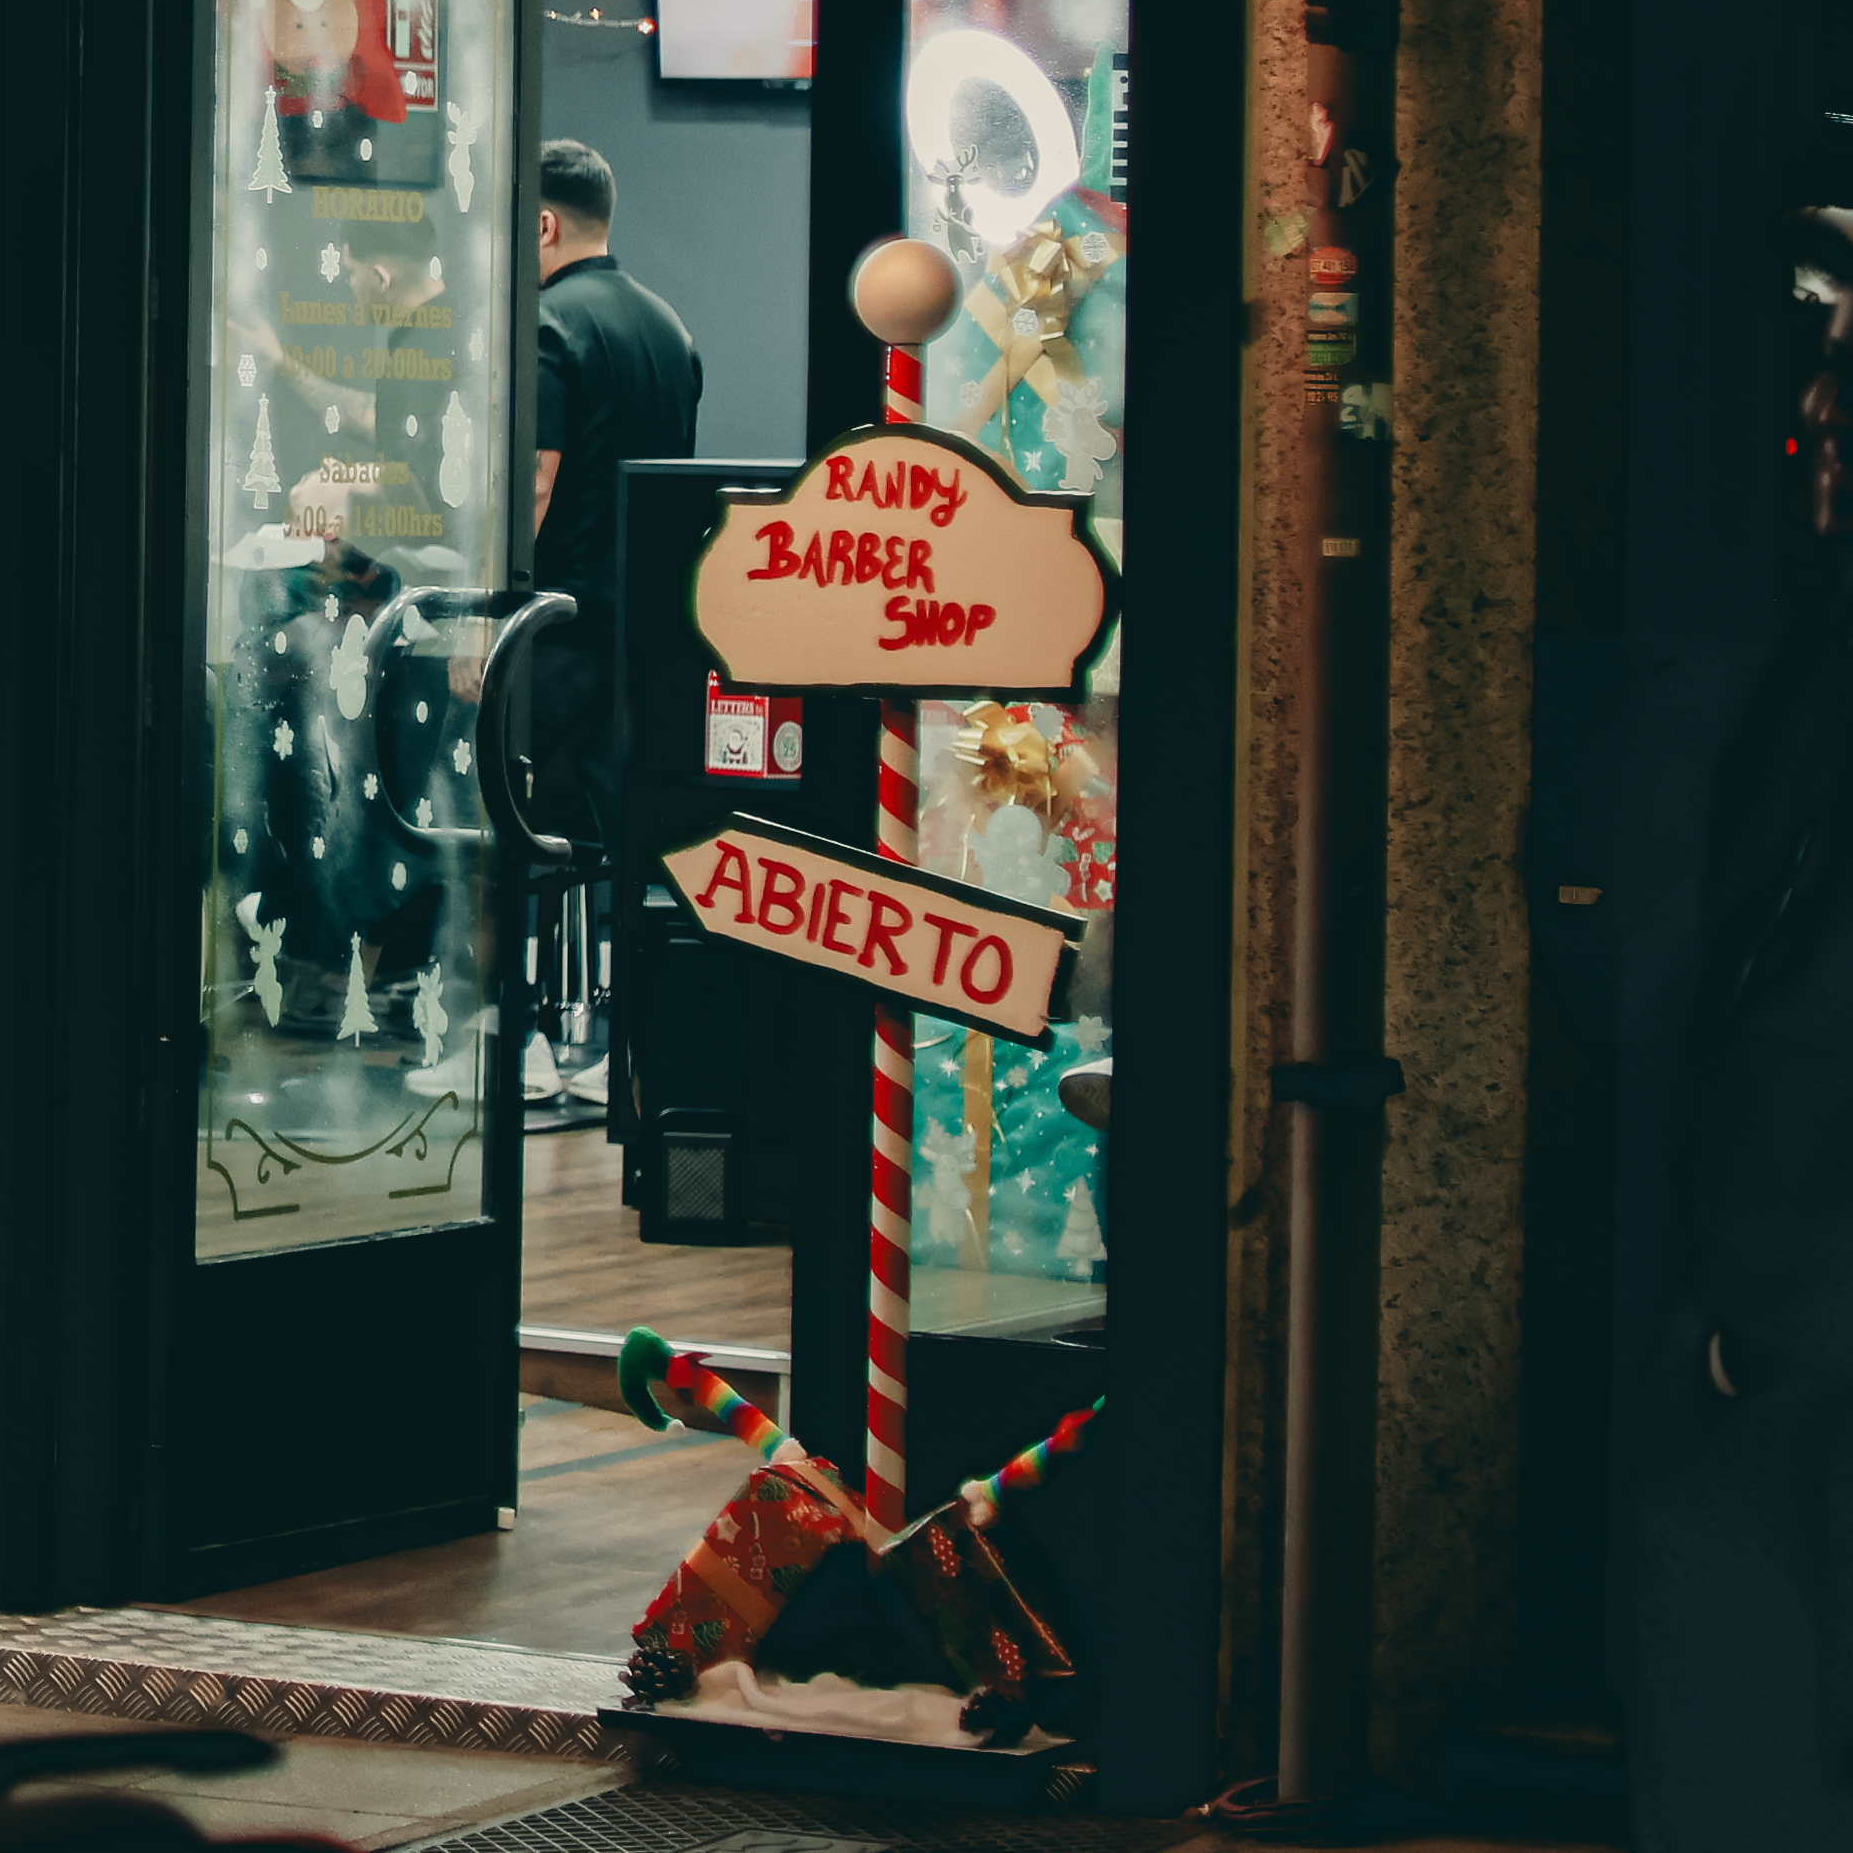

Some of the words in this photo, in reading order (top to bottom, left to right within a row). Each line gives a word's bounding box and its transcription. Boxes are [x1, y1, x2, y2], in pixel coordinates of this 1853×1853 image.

[312, 186, 425, 223] HORARIO
[280, 292, 347, 325] Lunes
[353, 303, 366, 326] a
[371, 302, 453, 329] viernes
[343, 355, 356, 379] a
[361, 347, 452, 381] 20:00hrs
[825, 455, 968, 527] RANDY
[334, 513, 347, 538] a
[353, 504, 443, 537] 14:00hrs
[747, 520, 935, 594] BARBER
[878, 597, 997, 652] SHOP
[695, 838, 1015, 1004] ABIERTO
